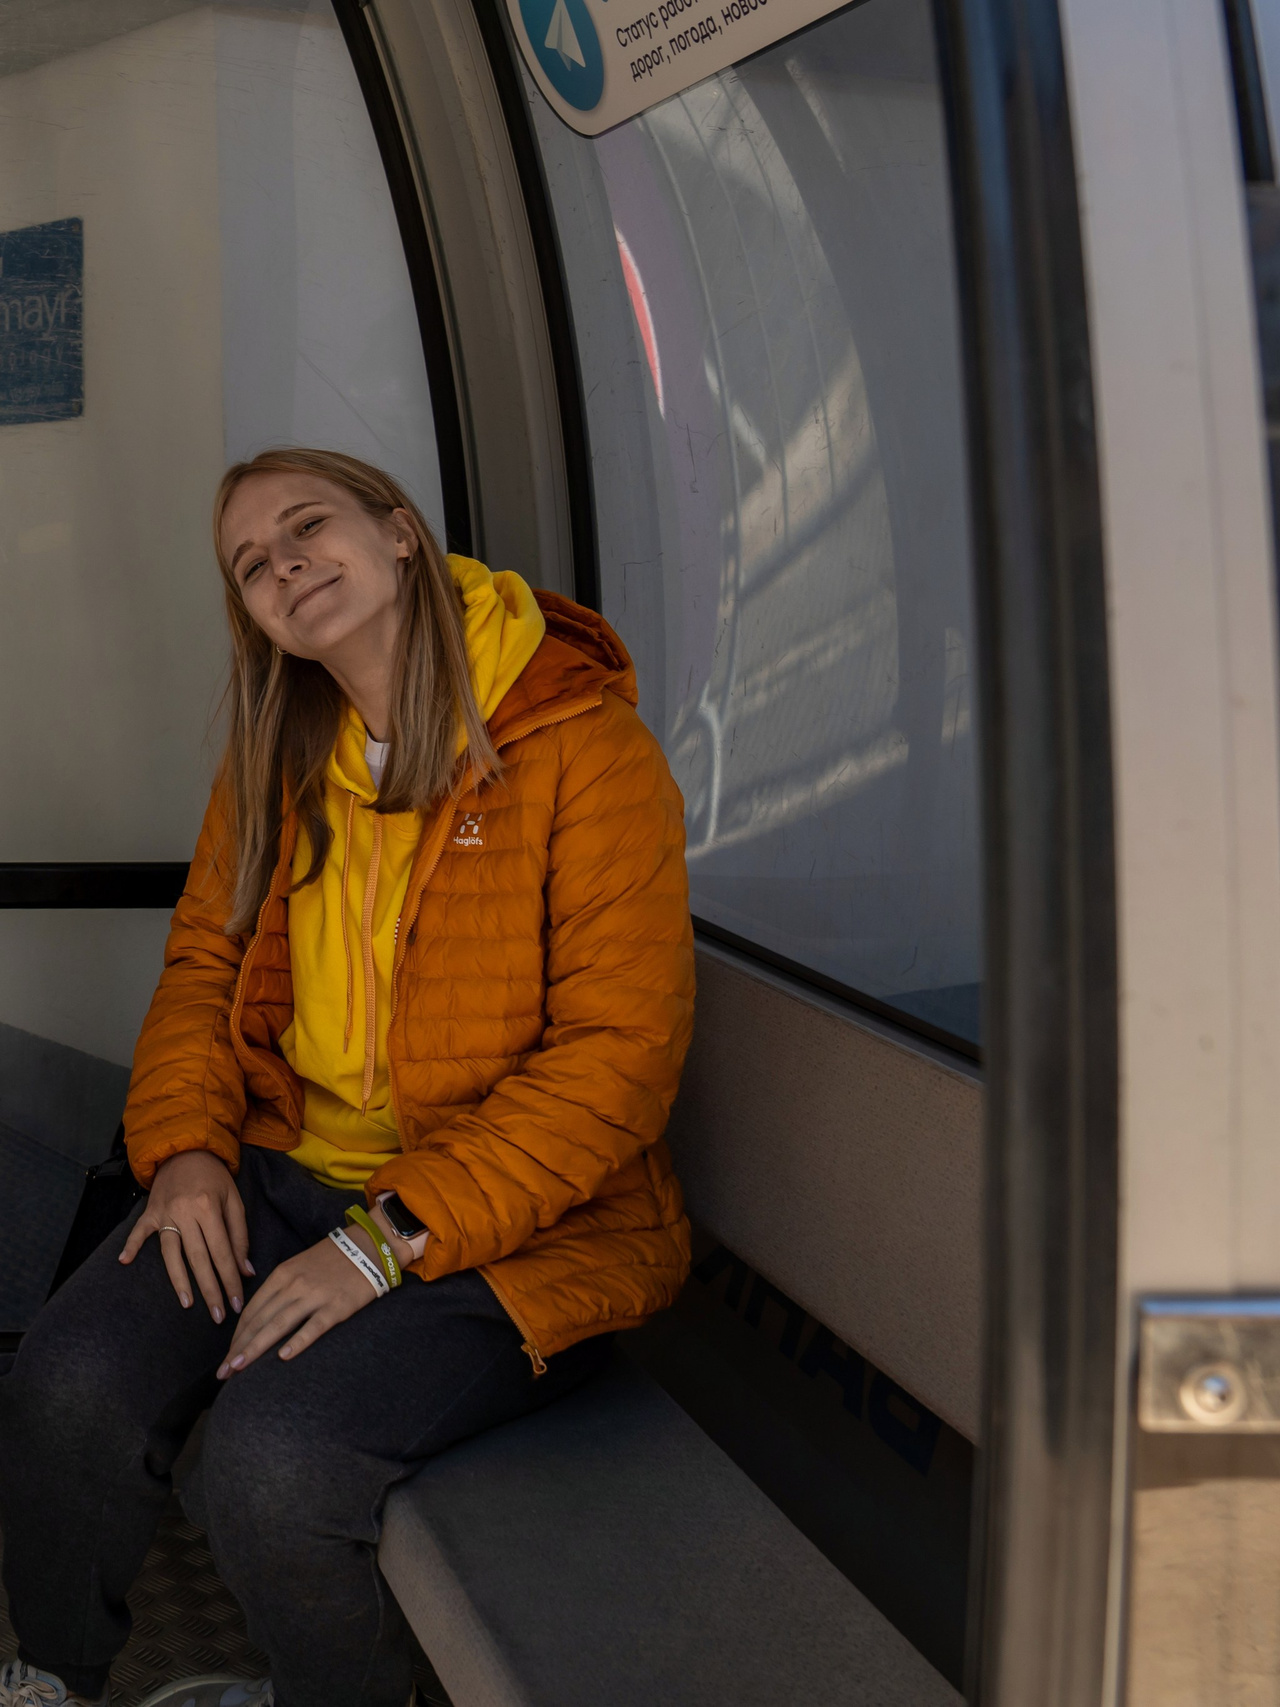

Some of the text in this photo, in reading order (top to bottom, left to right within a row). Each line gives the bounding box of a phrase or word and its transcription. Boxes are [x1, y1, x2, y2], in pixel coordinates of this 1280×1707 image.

[616, 13, 659, 47] Статус
[630, 46, 671, 82] дорог,
[669, 15, 723, 56] погода,
[453, 836, 483, 847] Haglöfs
